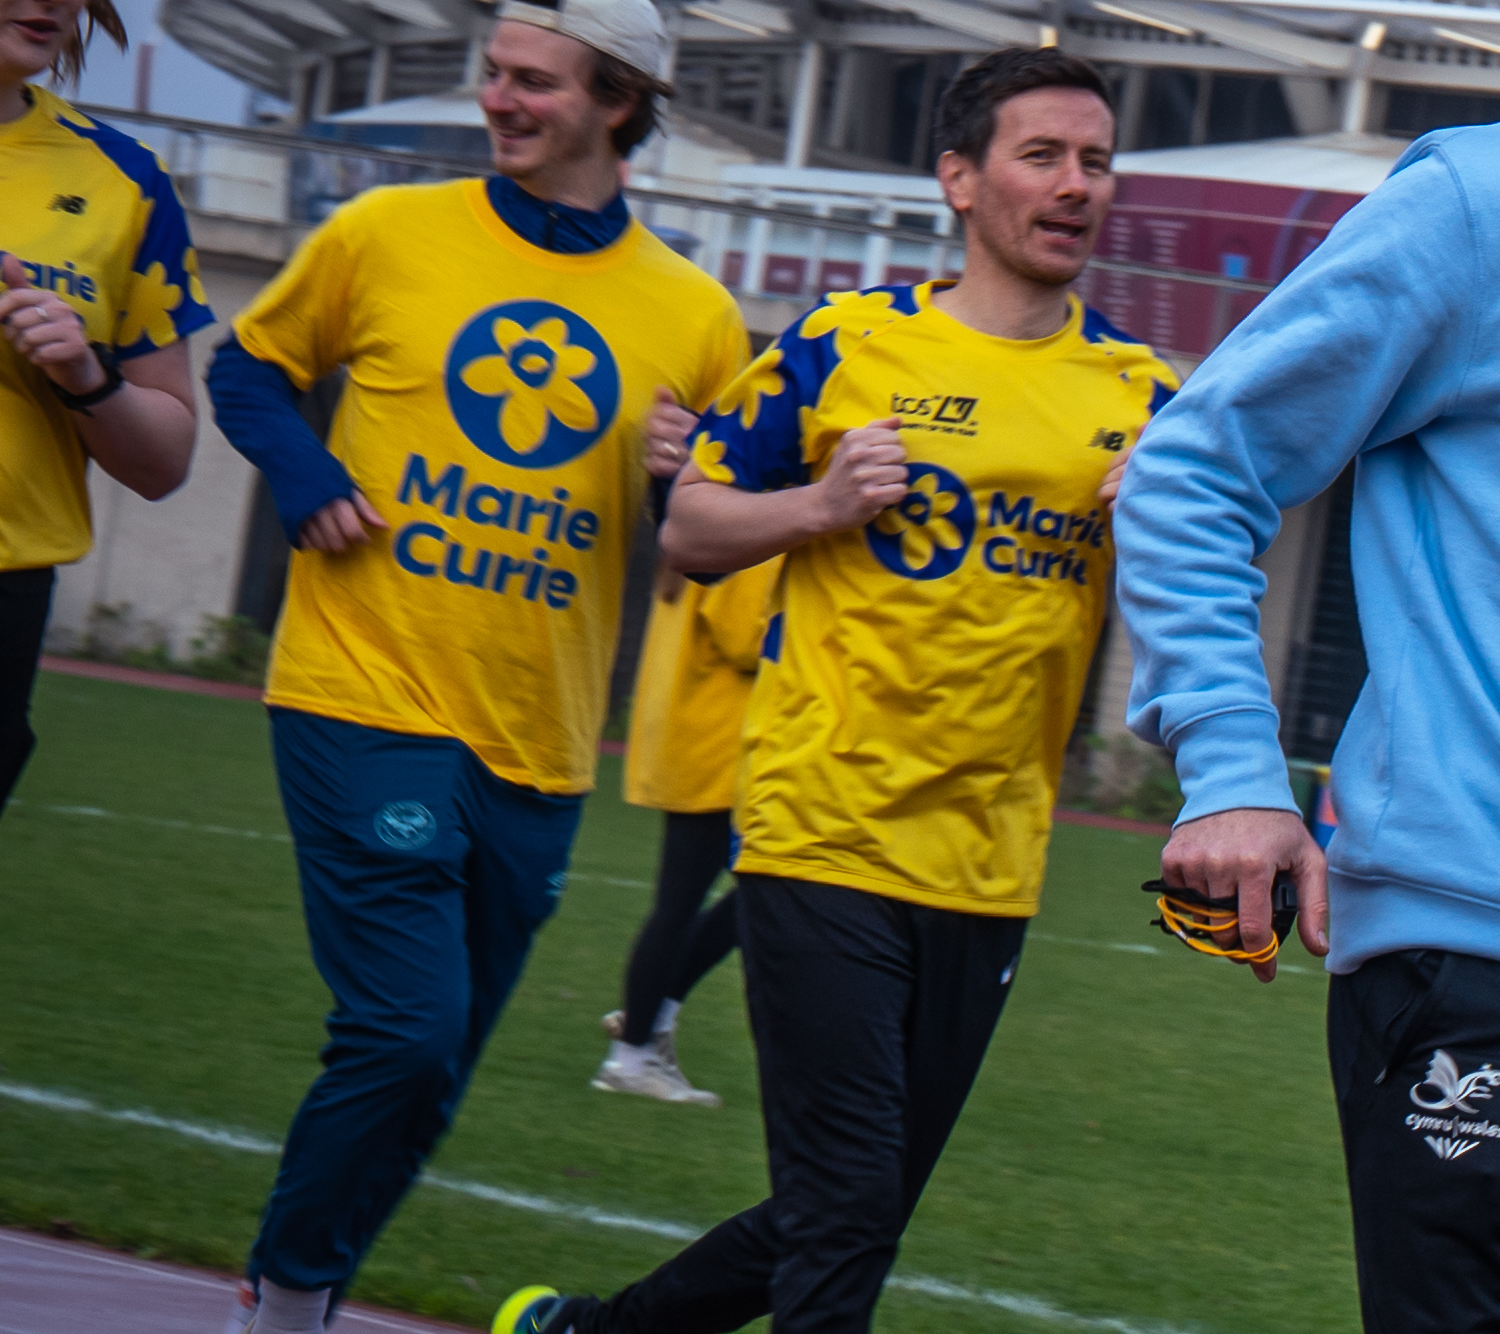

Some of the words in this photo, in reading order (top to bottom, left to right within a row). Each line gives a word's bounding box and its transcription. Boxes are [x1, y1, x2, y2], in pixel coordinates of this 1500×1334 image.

[4, 252, 97, 303] arie
[395, 451, 600, 551] Marie
[390, 519, 579, 610] Curie
